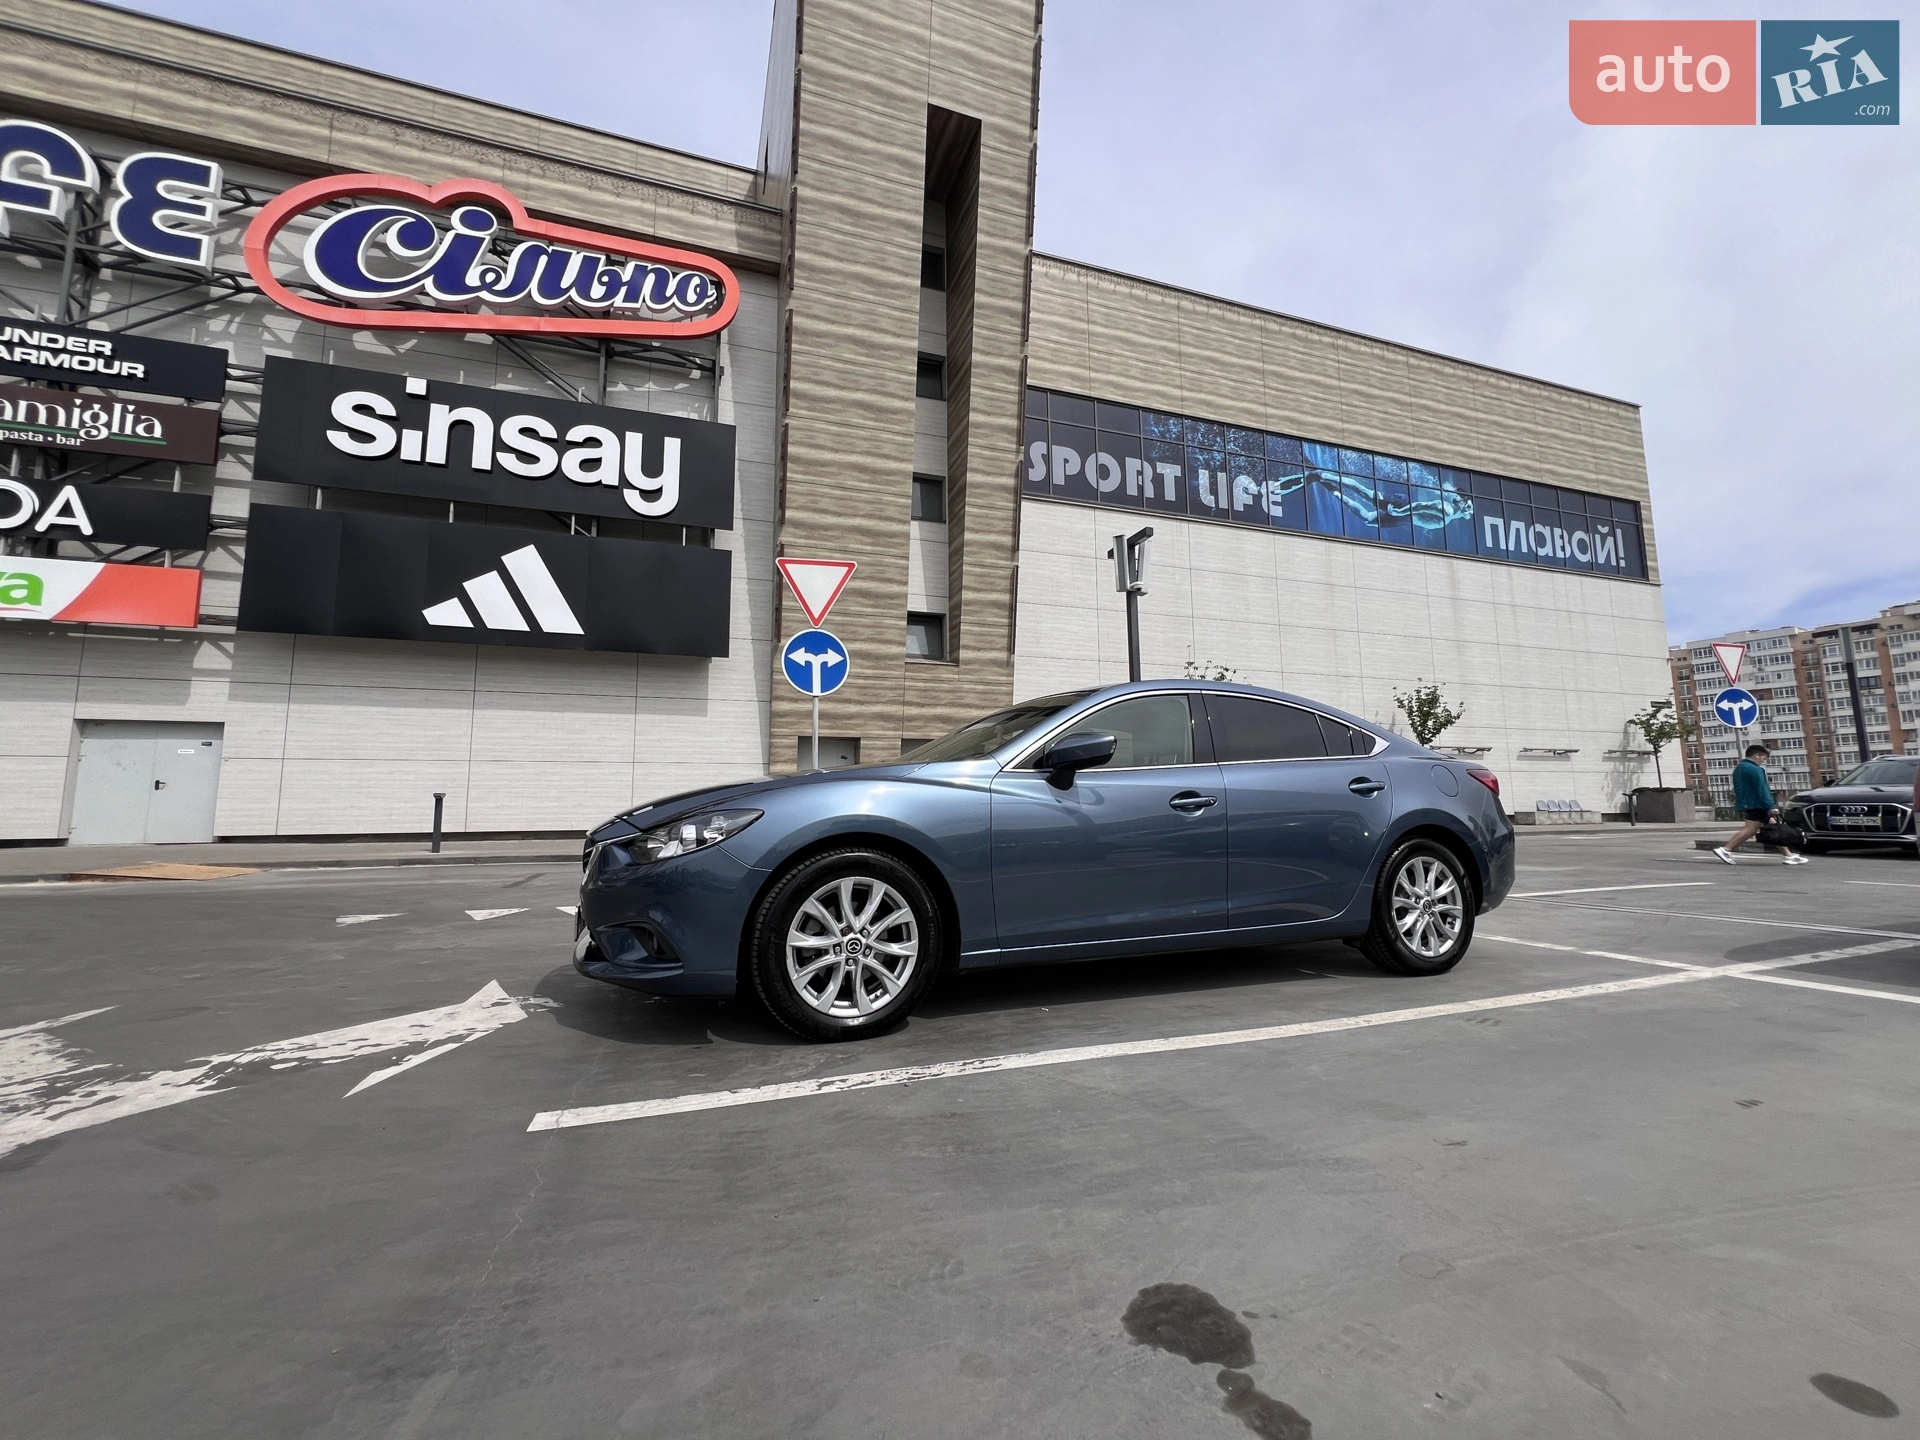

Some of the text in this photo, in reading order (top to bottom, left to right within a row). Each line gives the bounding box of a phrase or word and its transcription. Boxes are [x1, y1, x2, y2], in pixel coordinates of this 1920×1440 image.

[303, 204, 717, 312] Сільпо
[0, 429, 85, 446] pasta bar
[326, 376, 682, 517] sinsay
[1028, 441, 1284, 518] SPORT LIFE
